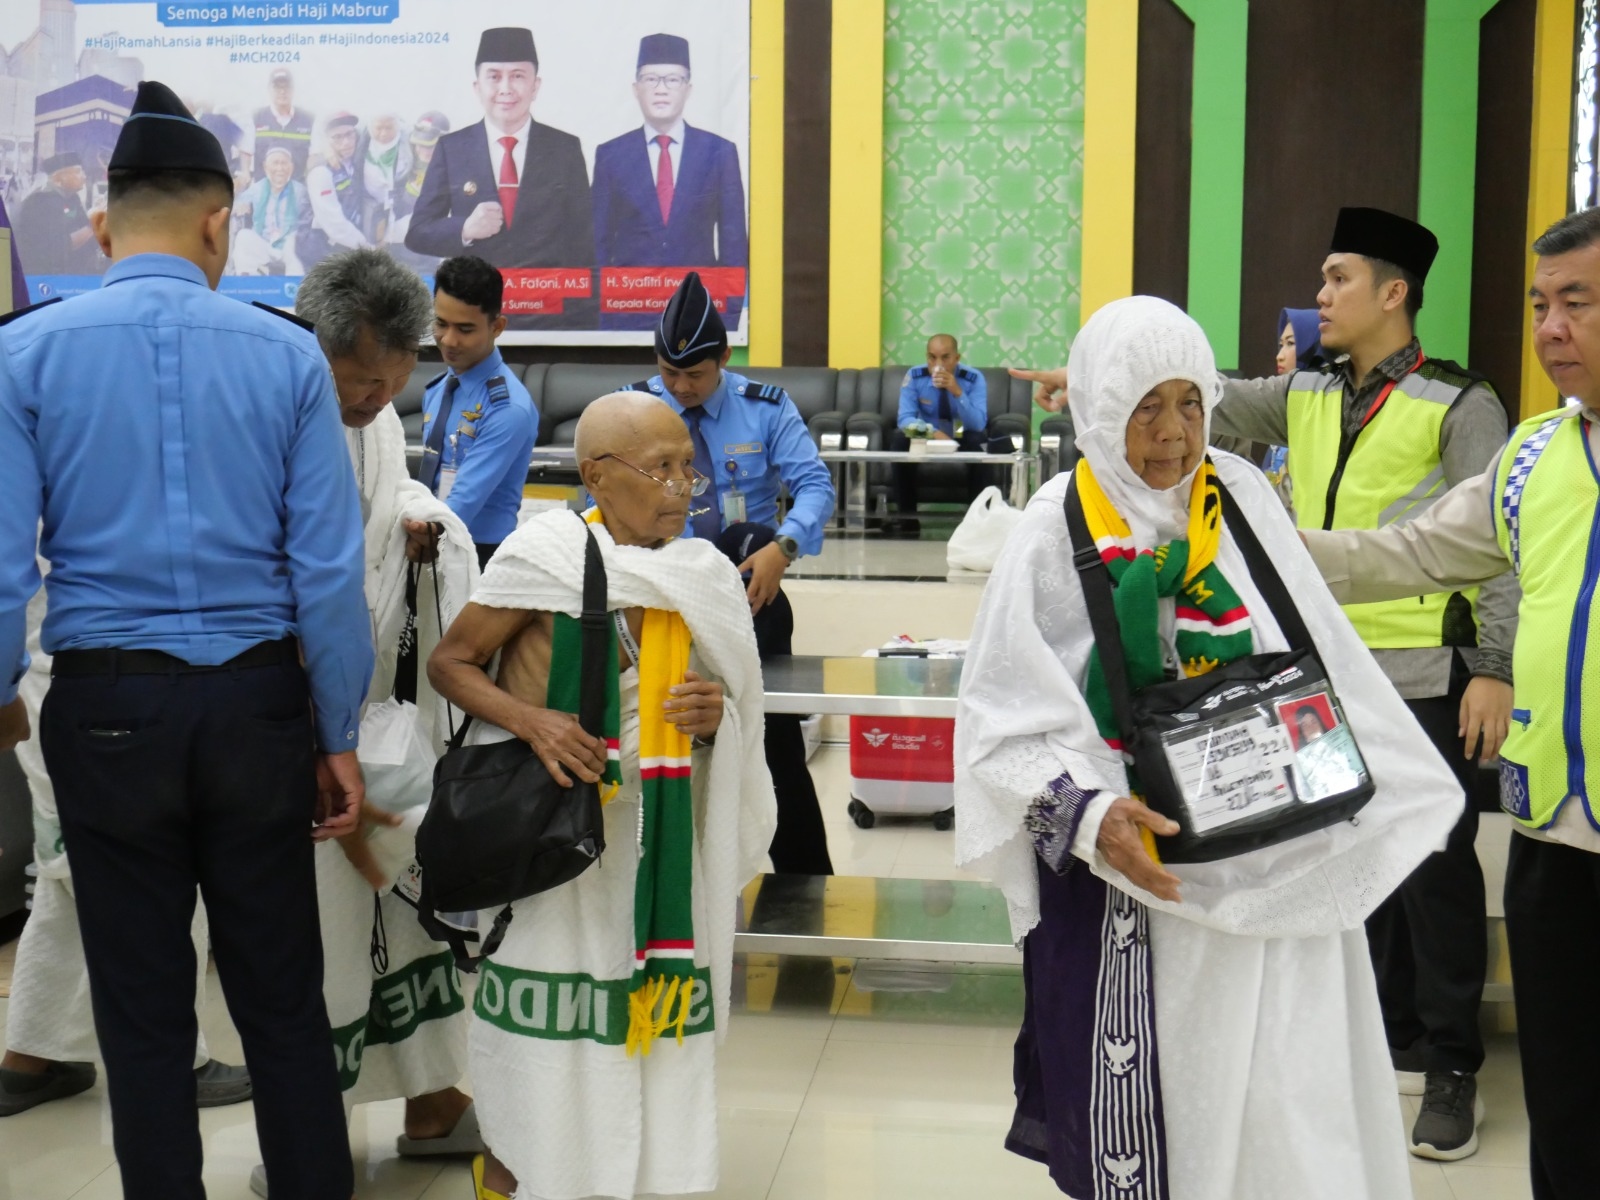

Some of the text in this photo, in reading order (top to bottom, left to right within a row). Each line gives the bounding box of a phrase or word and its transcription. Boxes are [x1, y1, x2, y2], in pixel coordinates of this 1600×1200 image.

[167, 3, 389, 22] Semoga Menjadi Haji Mabrur
[84, 32, 450, 50] #HajiRamahLansia #HajiBerkeadilan #HajiIndonesia2024
[229, 52, 301, 63] #MCH2024
[504, 278, 517, 289] A.
[606, 276, 685, 290] H. Syafitri Irw
[508, 299, 544, 310] Sumsel
[606, 299, 643, 310] Kepala
